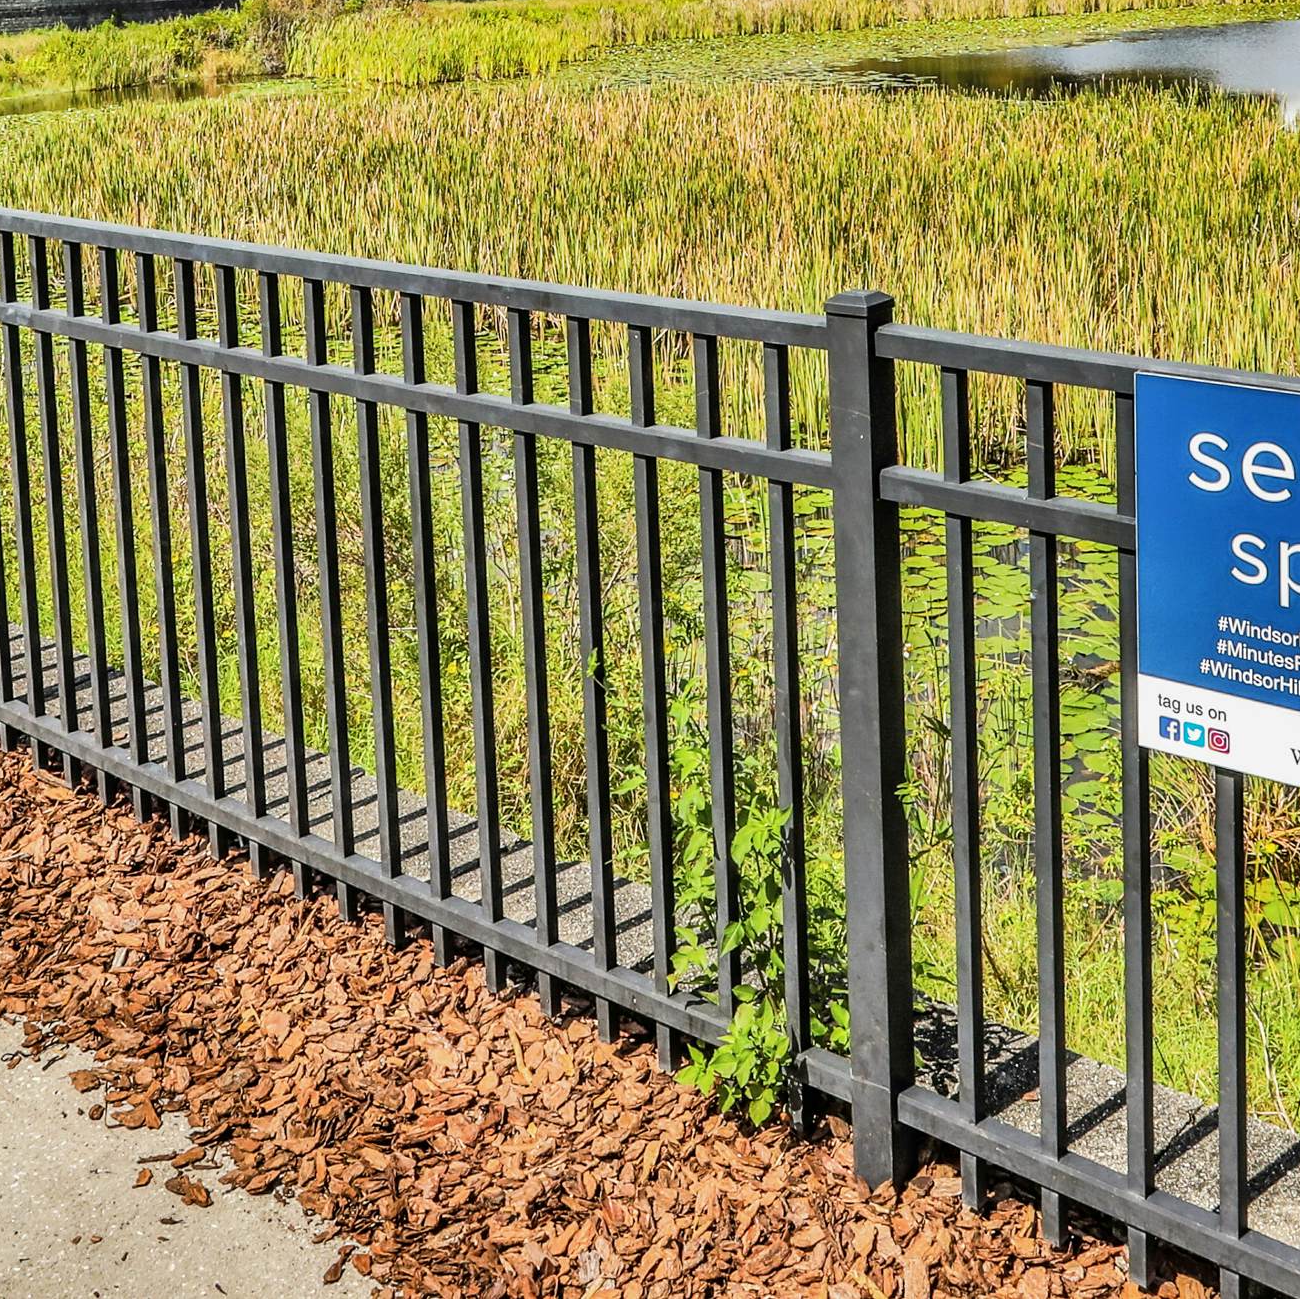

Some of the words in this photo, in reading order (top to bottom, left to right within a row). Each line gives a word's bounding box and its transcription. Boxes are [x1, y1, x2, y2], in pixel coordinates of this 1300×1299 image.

[1158, 693, 1180, 714] tag
[1186, 702, 1203, 716] us
[1208, 708, 1227, 722] on
